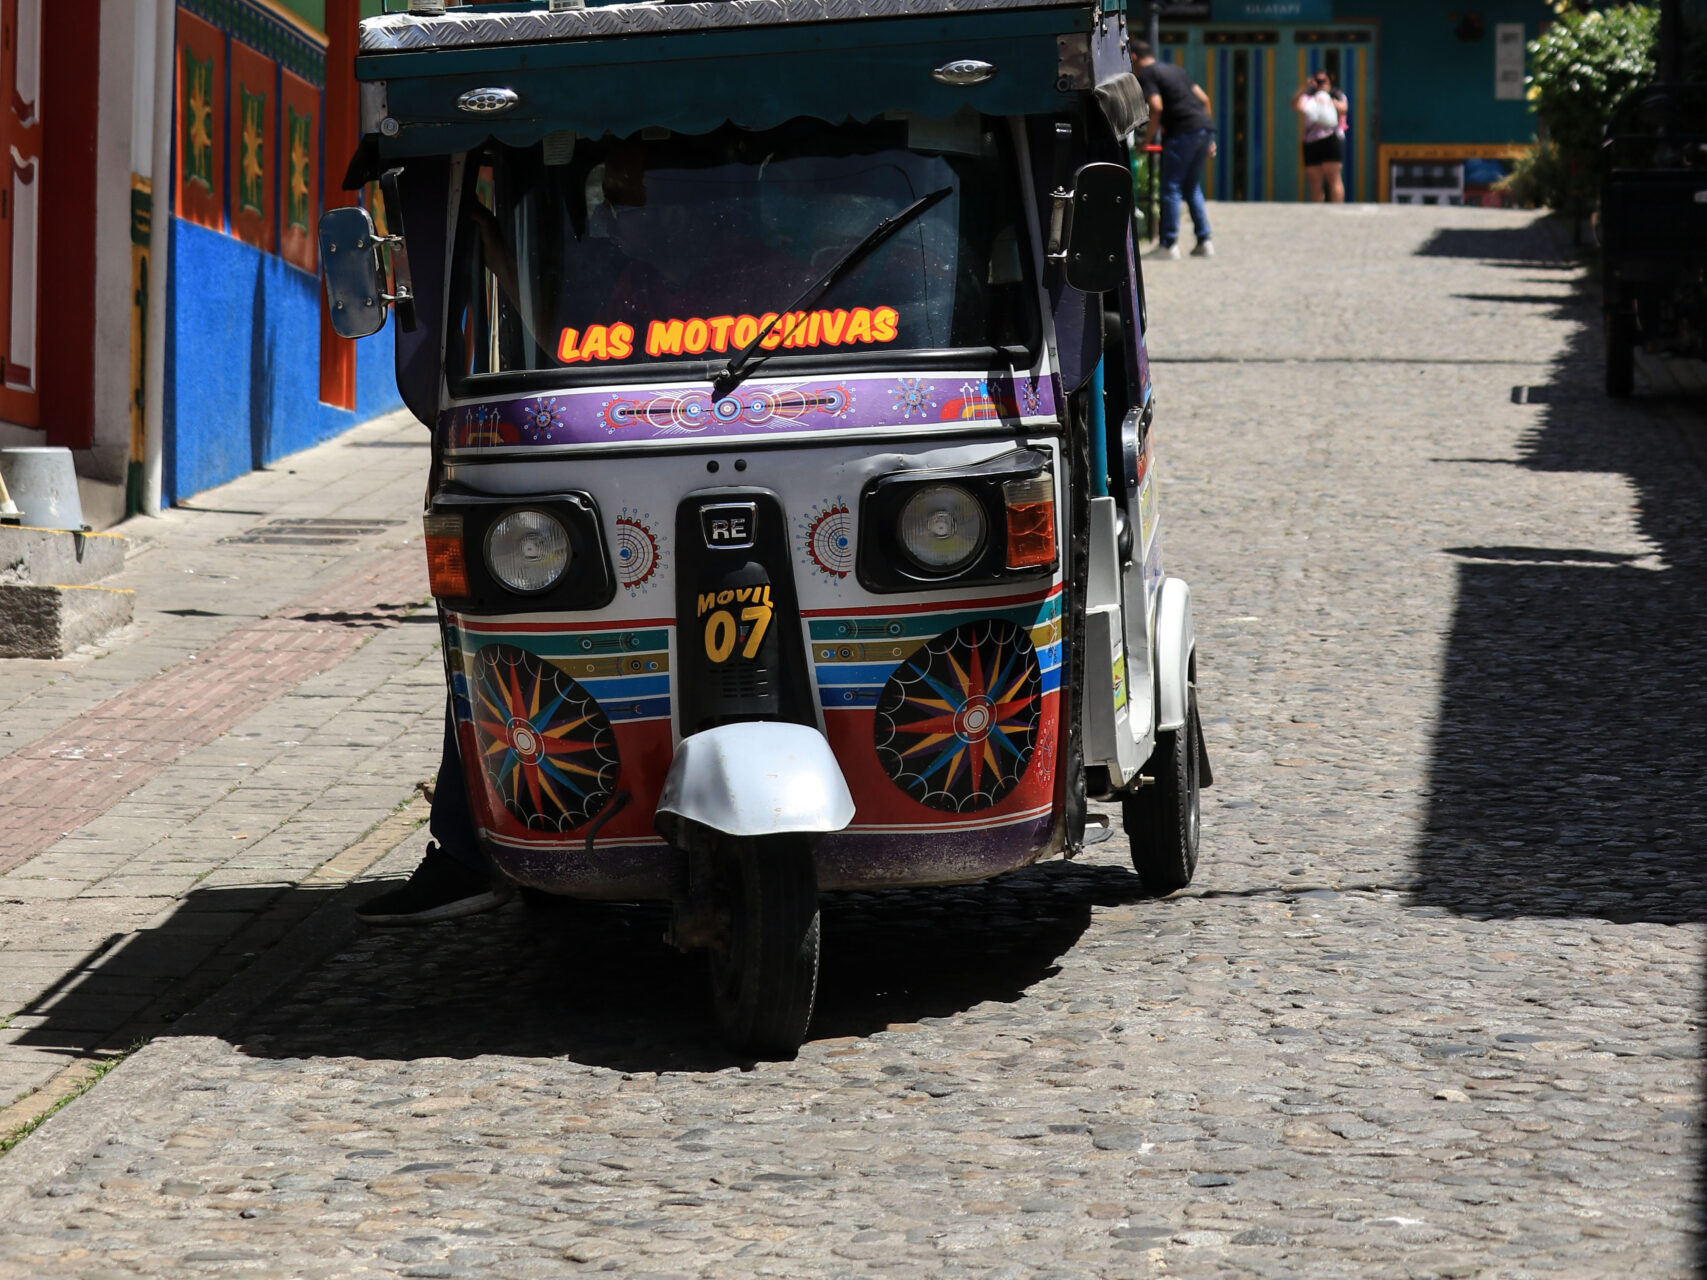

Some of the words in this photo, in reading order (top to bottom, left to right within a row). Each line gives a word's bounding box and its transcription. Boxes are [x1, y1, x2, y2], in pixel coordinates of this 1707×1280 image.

[558, 323, 634, 363] LAS
[646, 306, 899, 358] MOTOCHIVAS
[712, 518, 748, 540] RE
[697, 585, 774, 618] MOVIL
[704, 605, 773, 664] 07
